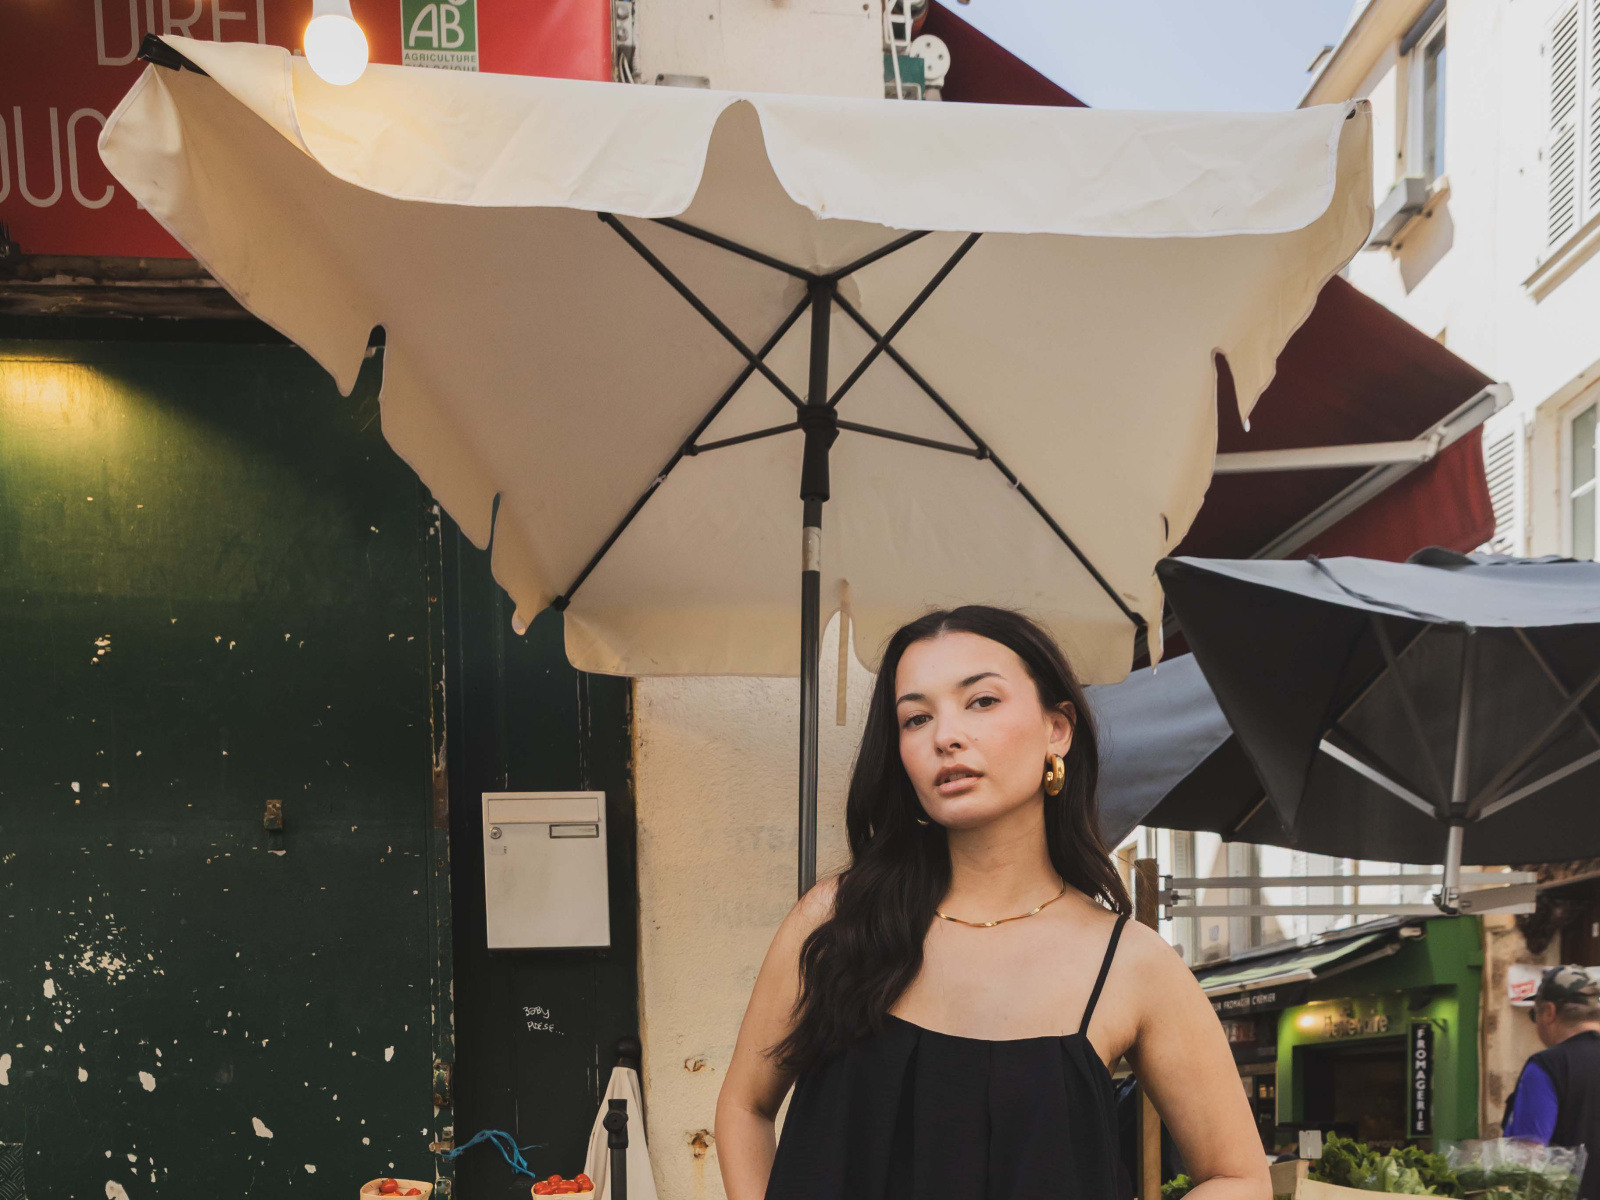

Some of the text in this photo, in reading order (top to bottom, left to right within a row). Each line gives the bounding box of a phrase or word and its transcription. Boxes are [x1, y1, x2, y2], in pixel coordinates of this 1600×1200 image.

[408, 3, 465, 49] AB
[404, 53, 477, 63] AGRICULTURE
[1415, 1028, 1427, 1131] FROMAGERIE
